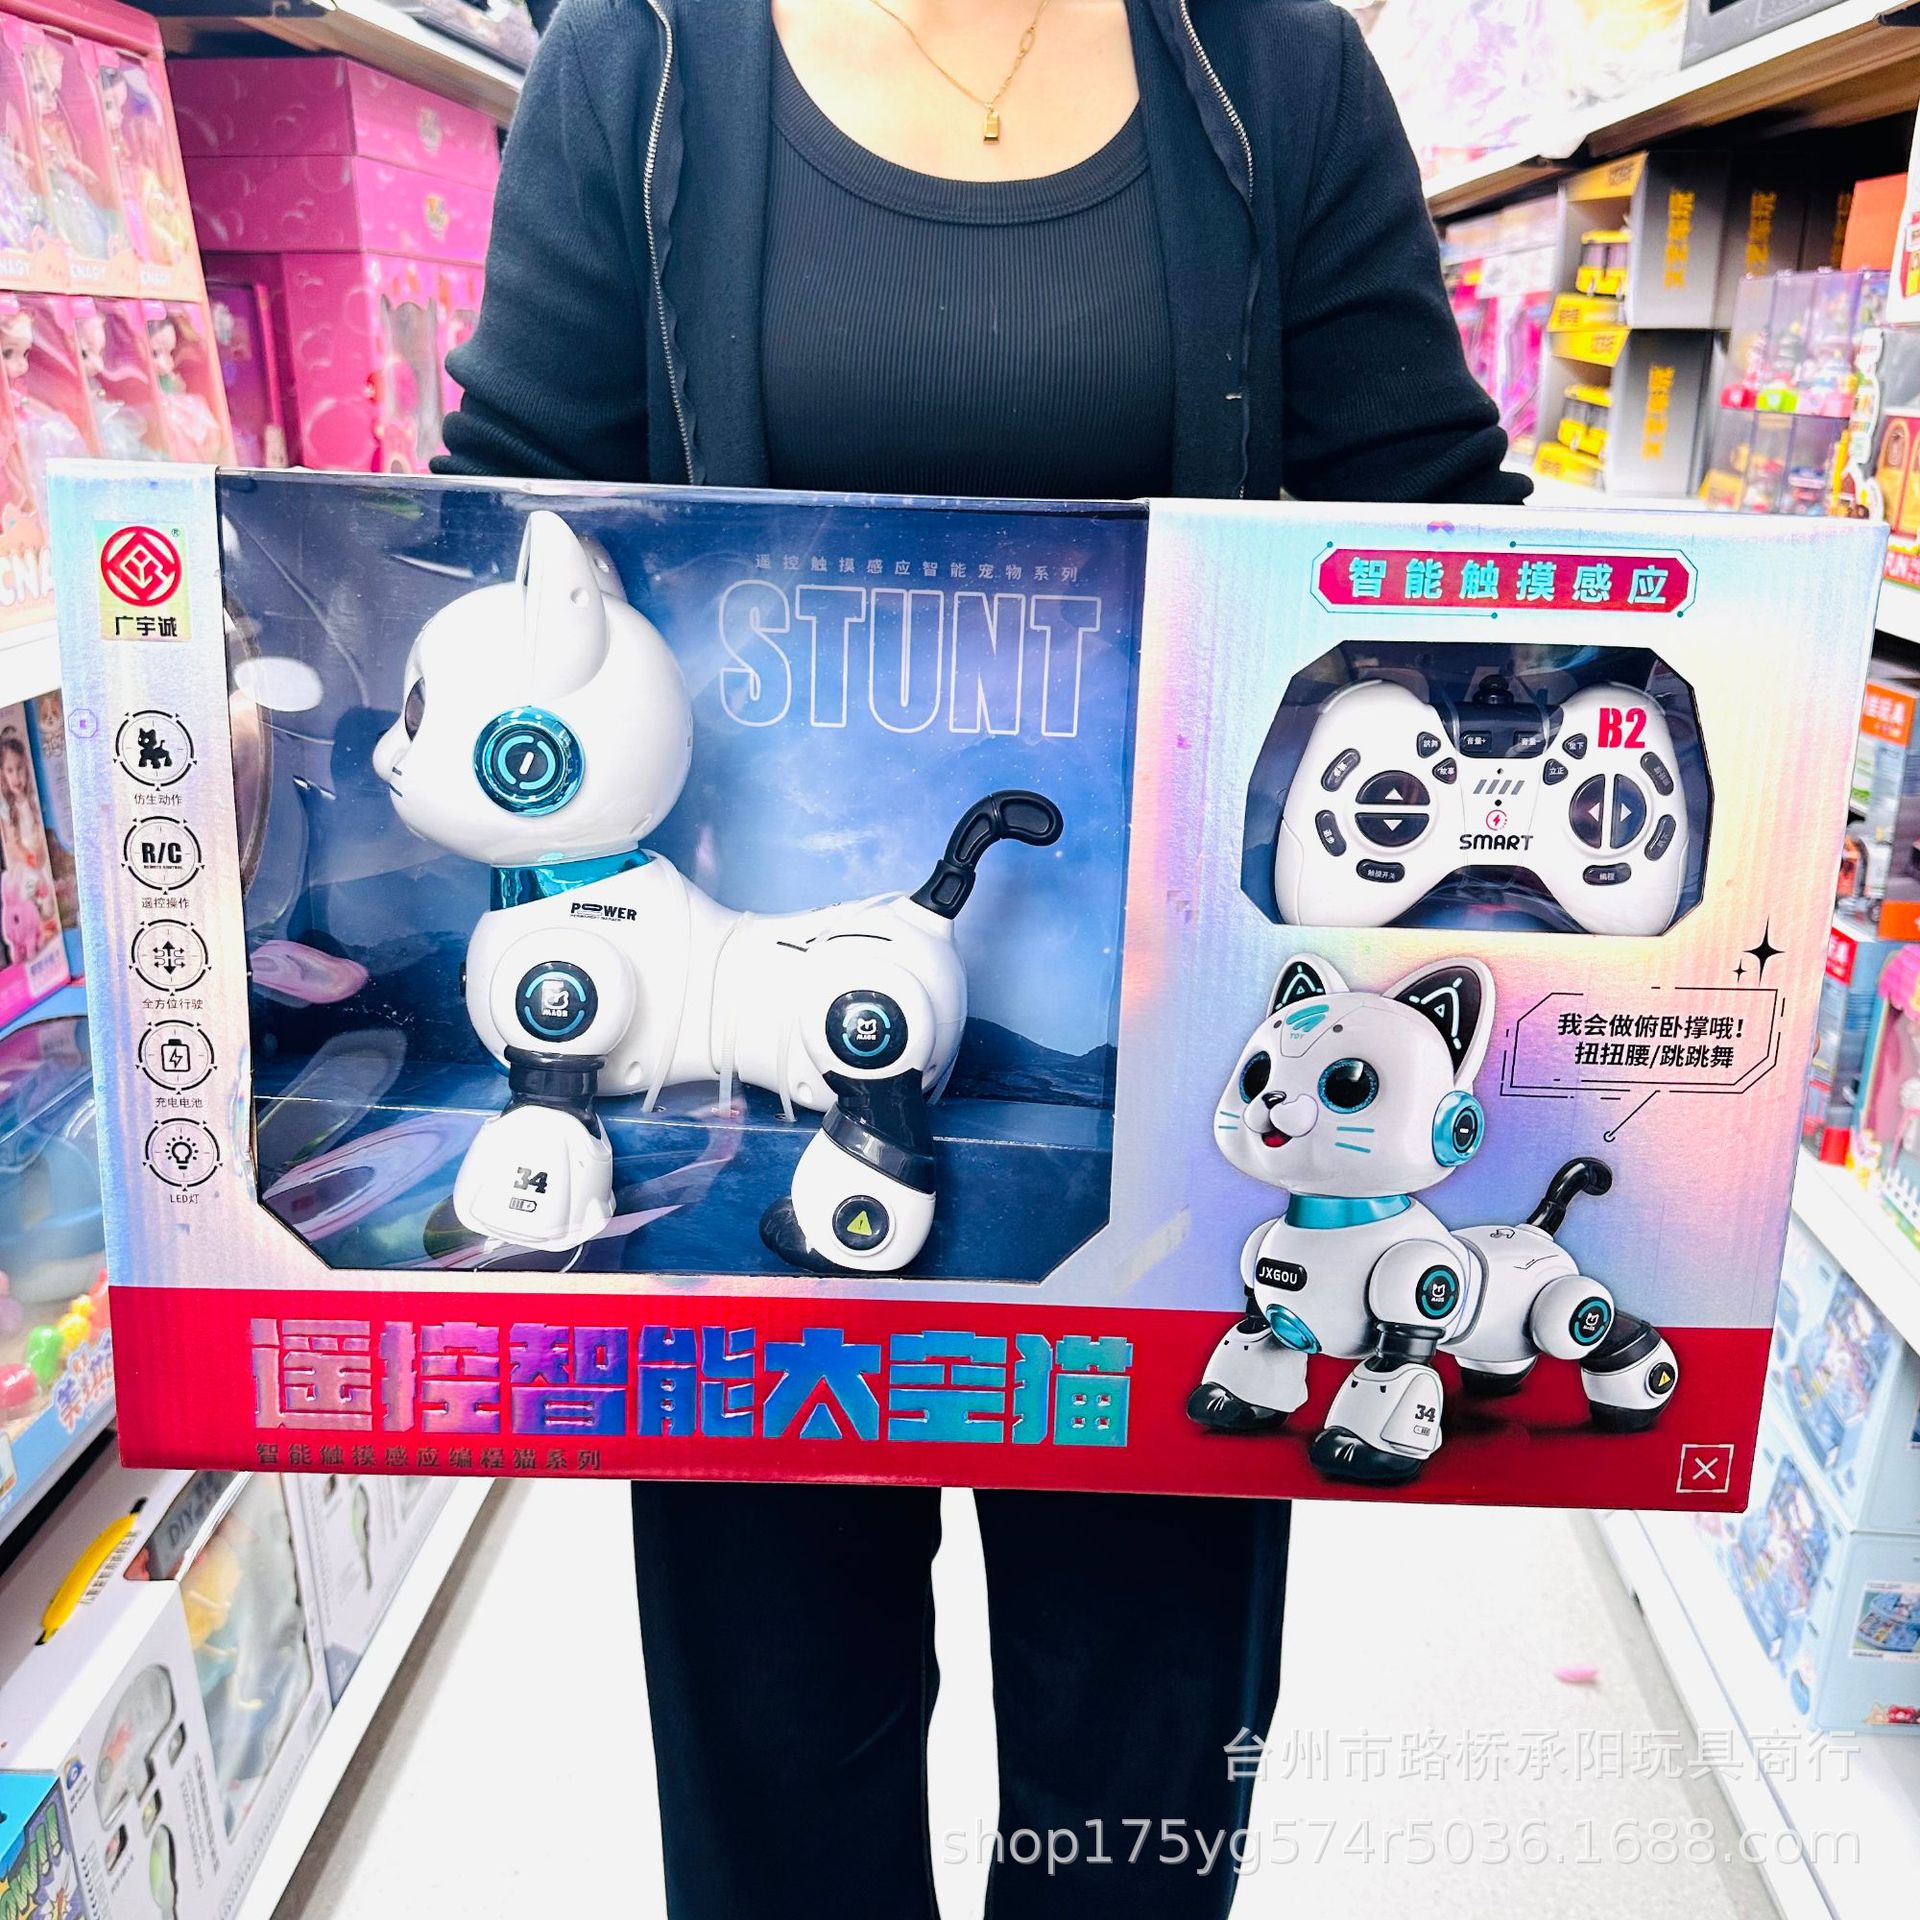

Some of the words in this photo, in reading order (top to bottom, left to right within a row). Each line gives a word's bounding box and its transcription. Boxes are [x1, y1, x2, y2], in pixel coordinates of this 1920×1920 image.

[755, 553, 1077, 582] 遥控触摸感应智能宠物系列
[1348, 557, 1670, 605] 智能触摸感应
[115, 615, 178, 637] 广宇诚
[719, 580, 1101, 737] STUNT
[1597, 707, 1647, 748] B2
[134, 794, 183, 806] 仿生动作
[1459, 833, 1534, 851] SMART
[142, 842, 182, 864] R/C
[142, 897, 190, 909] 遥控操作
[570, 902, 638, 921] POWER
[142, 998, 204, 1010] 全方位行驶
[1574, 1041, 1735, 1069] 扭扭腰/跳跳舞
[155, 1097, 204, 1109] 充电电池
[513, 1166, 548, 1194] 34
[169, 1193, 200, 1204] LED灯
[1258, 1265, 1298, 1285] JXGOU
[1414, 1403, 1437, 1423] 34
[256, 1443, 601, 1471] 智能触摸感应编程猫系列
